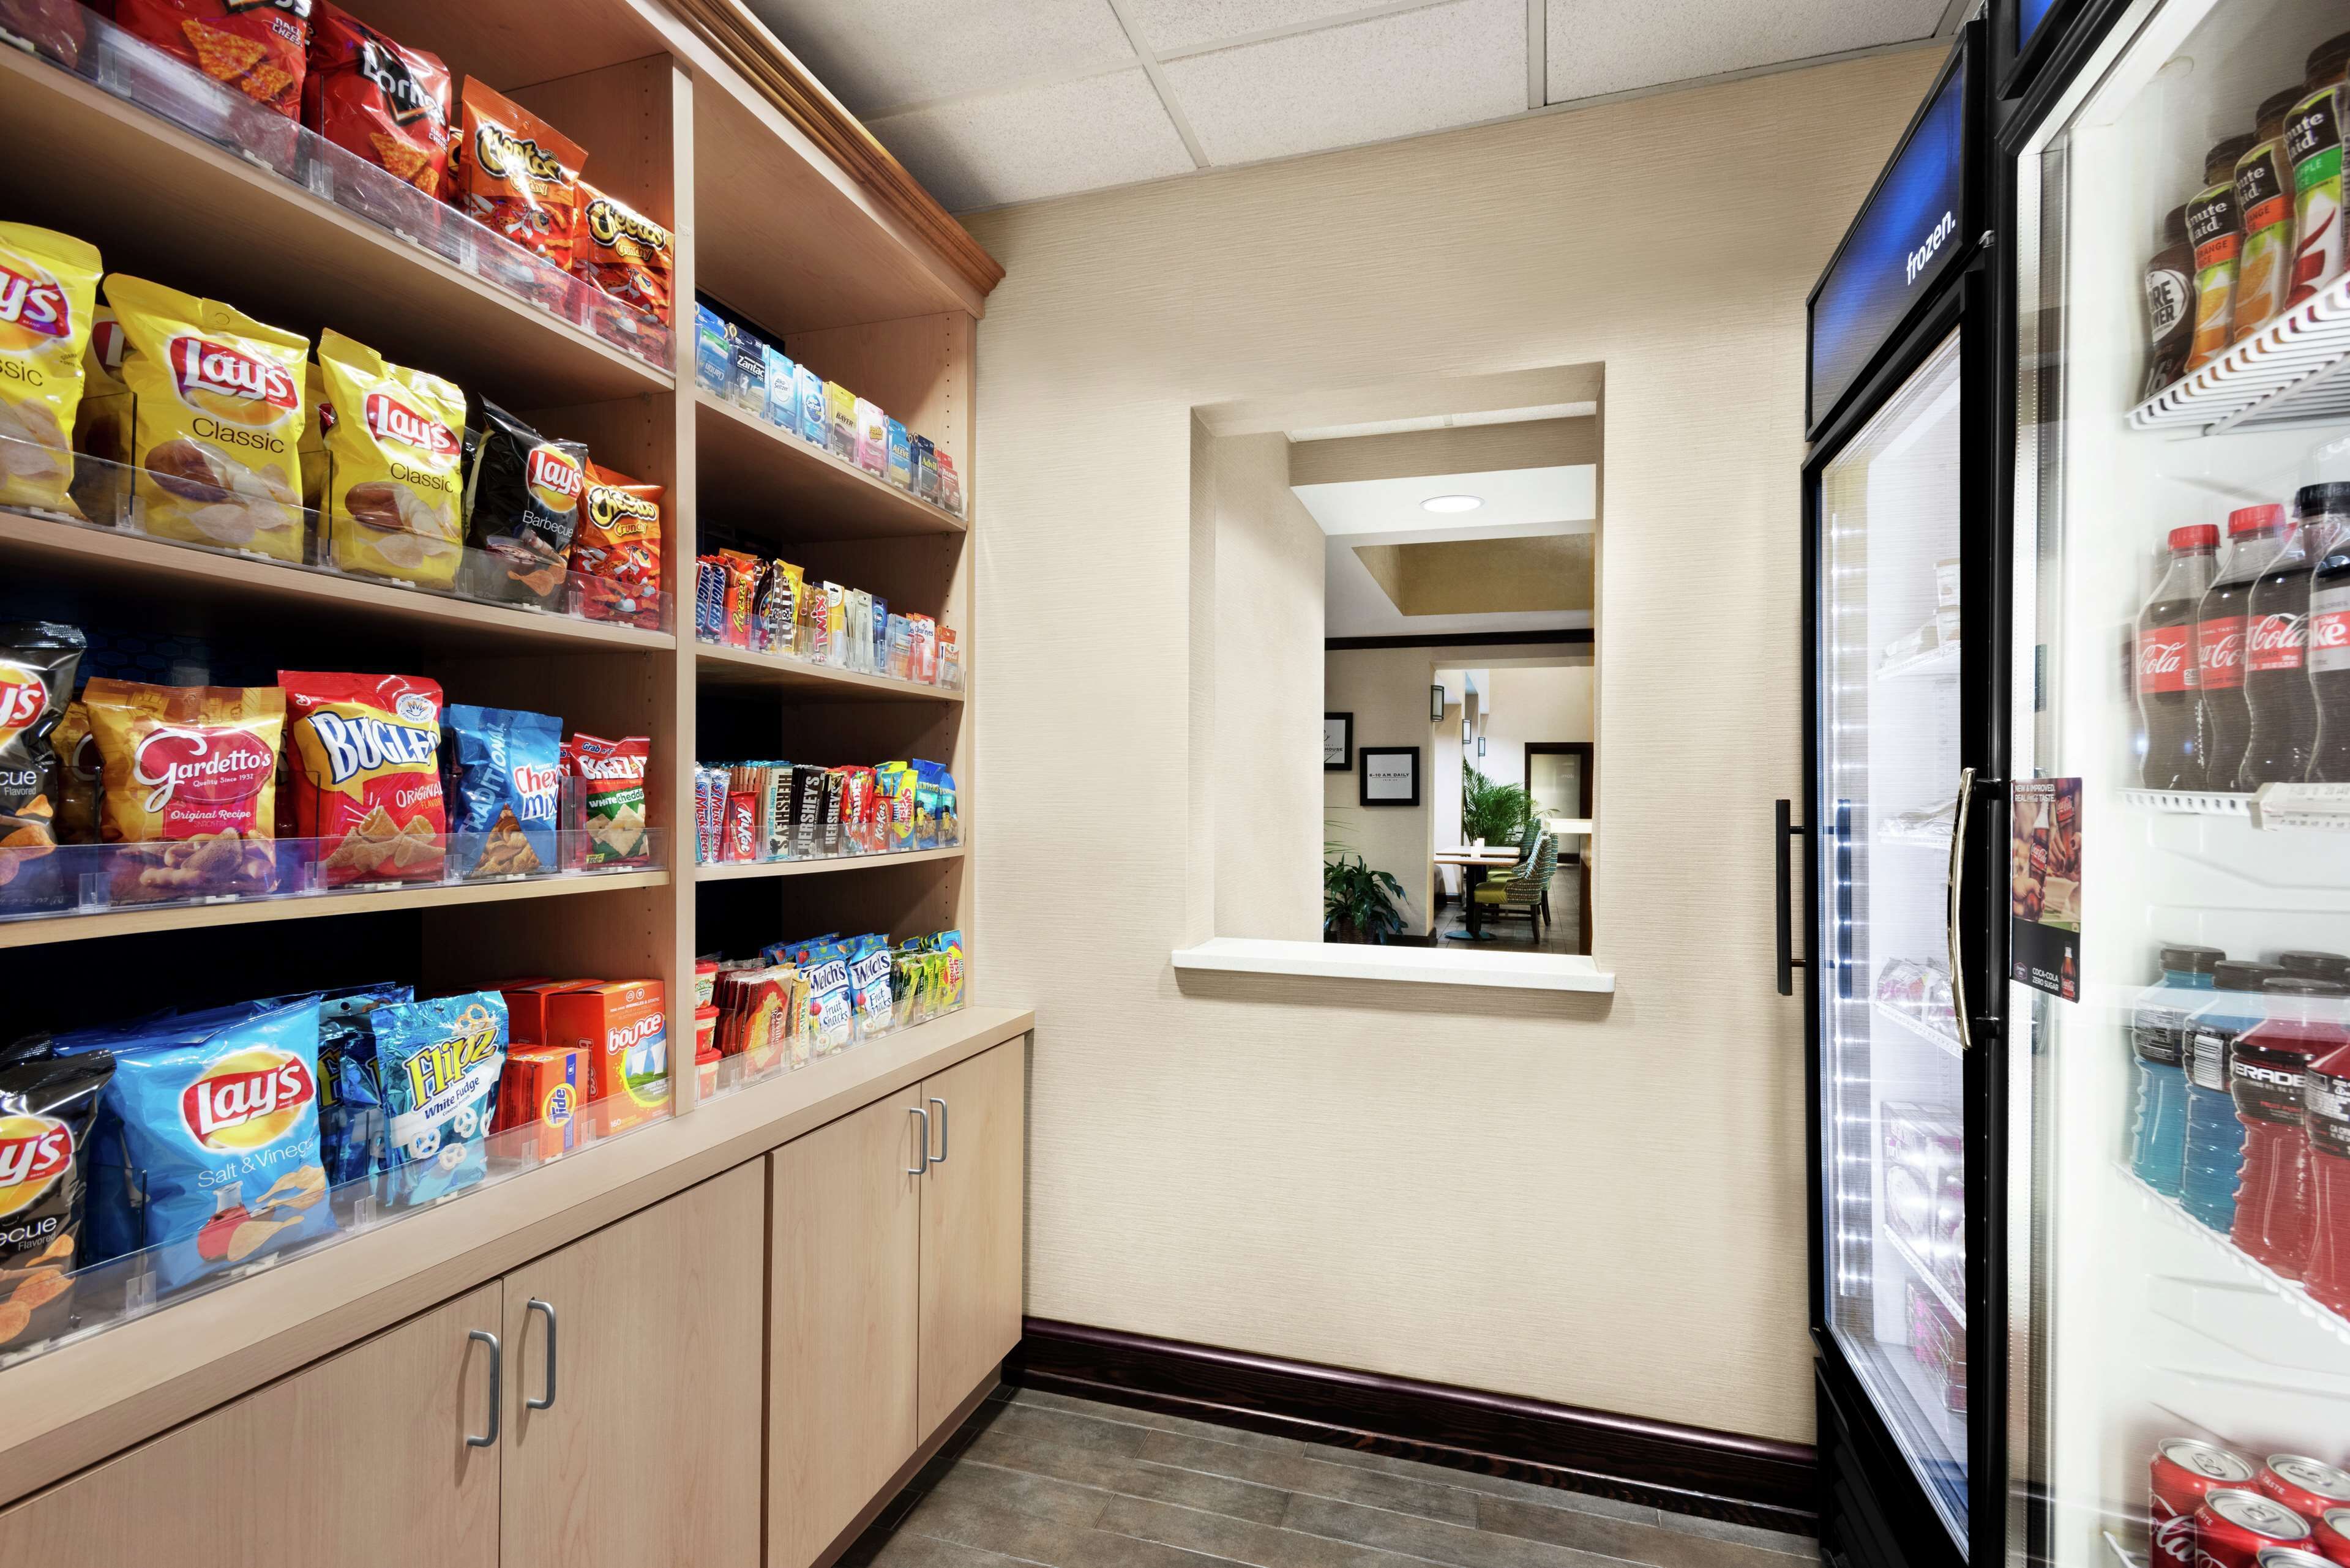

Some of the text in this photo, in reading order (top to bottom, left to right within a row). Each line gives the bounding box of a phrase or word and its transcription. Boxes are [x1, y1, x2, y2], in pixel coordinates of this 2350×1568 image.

[272, 24, 303, 47] CHEES
[586, 199, 665, 250] Cheetos
[2195, 216, 2220, 239] aid
[616, 239, 651, 261] Crunchy
[1906, 211, 1956, 286] frozen.
[0, 272, 60, 323] y's
[23, 319, 40, 328] BRAND
[184, 338, 288, 401] Lay's
[737, 356, 764, 376] Zantac
[375, 395, 451, 450] Lay's
[836, 413, 853, 427] BAYER
[193, 417, 285, 454] Classic
[892, 445, 909, 458] ALEVE
[922, 457, 937, 471] Advil
[391, 463, 454, 493] Classic
[531, 451, 582, 495] Lay's
[589, 485, 657, 529] Cheetos
[522, 510, 574, 538] Barbecue
[613, 523, 648, 537] Crunchy
[733, 578, 746, 633] Reese's
[811, 595, 828, 652] TWIX
[2314, 620, 2346, 647] ke
[582, 742, 600, 753] Grab
[133, 731, 271, 813] Gardetto's
[458, 723, 505, 839] TRADITIONAL
[515, 766, 559, 794] Chex
[4, 786, 37, 796] Flavored
[421, 798, 441, 809] FLAVOR
[524, 788, 557, 819] mix
[171, 810, 251, 822] Original Recipe
[775, 775, 792, 849] HERSHEY'S
[798, 776, 820, 849] HERSHEY'S
[825, 786, 840, 845] HERSHEY'S
[695, 796, 708, 861] Musketeers
[711, 796, 723, 861] Musketeers
[811, 964, 846, 991] Welch's
[853, 955, 890, 984] Welch's
[2032, 968, 2059, 983] COCA-COLA
[2032, 976, 2059, 991] ZERO SUGAR
[823, 1010, 847, 1028] Snacks
[826, 1001, 842, 1015] Fruit
[608, 1014, 662, 1052] bounce
[404, 1026, 498, 1111] Flipz
[2235, 1062, 2307, 1088] ERADE
[198, 1064, 302, 1135] Lay's
[425, 1077, 480, 1119] White Fudge
[550, 1088, 570, 1125] Tide
[0, 1132, 64, 1186] y's
[198, 1138, 313, 1187] Salt & Vinega
[18, 1231, 56, 1251] Flavored
[2264, 1475, 2286, 1495] TASTE
